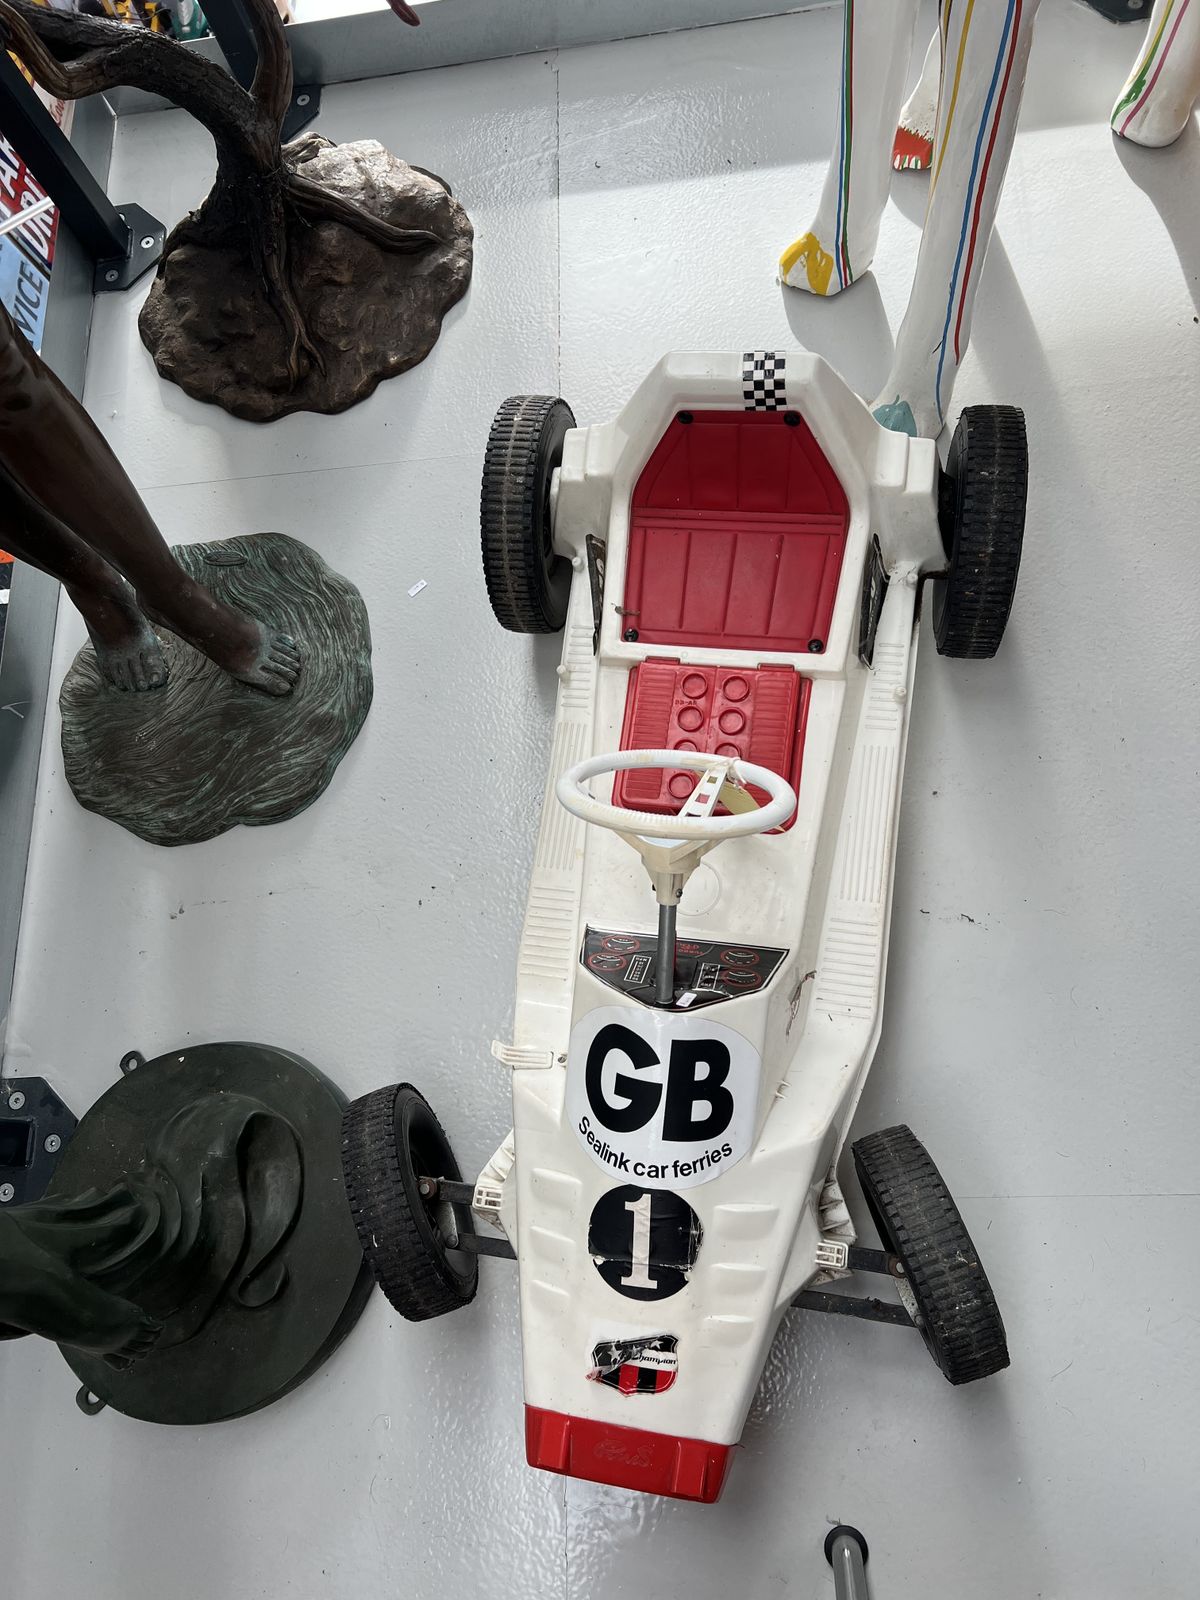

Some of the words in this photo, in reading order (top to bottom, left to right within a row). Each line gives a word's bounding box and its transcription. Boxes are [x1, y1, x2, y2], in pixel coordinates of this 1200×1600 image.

[13, 260, 43, 347] VICE
[585, 1023, 735, 1143] GB
[578, 1116, 631, 1173] Sealink
[633, 1162, 668, 1178] car
[672, 1143, 733, 1178] ferries
[621, 1193, 658, 1289] 1
